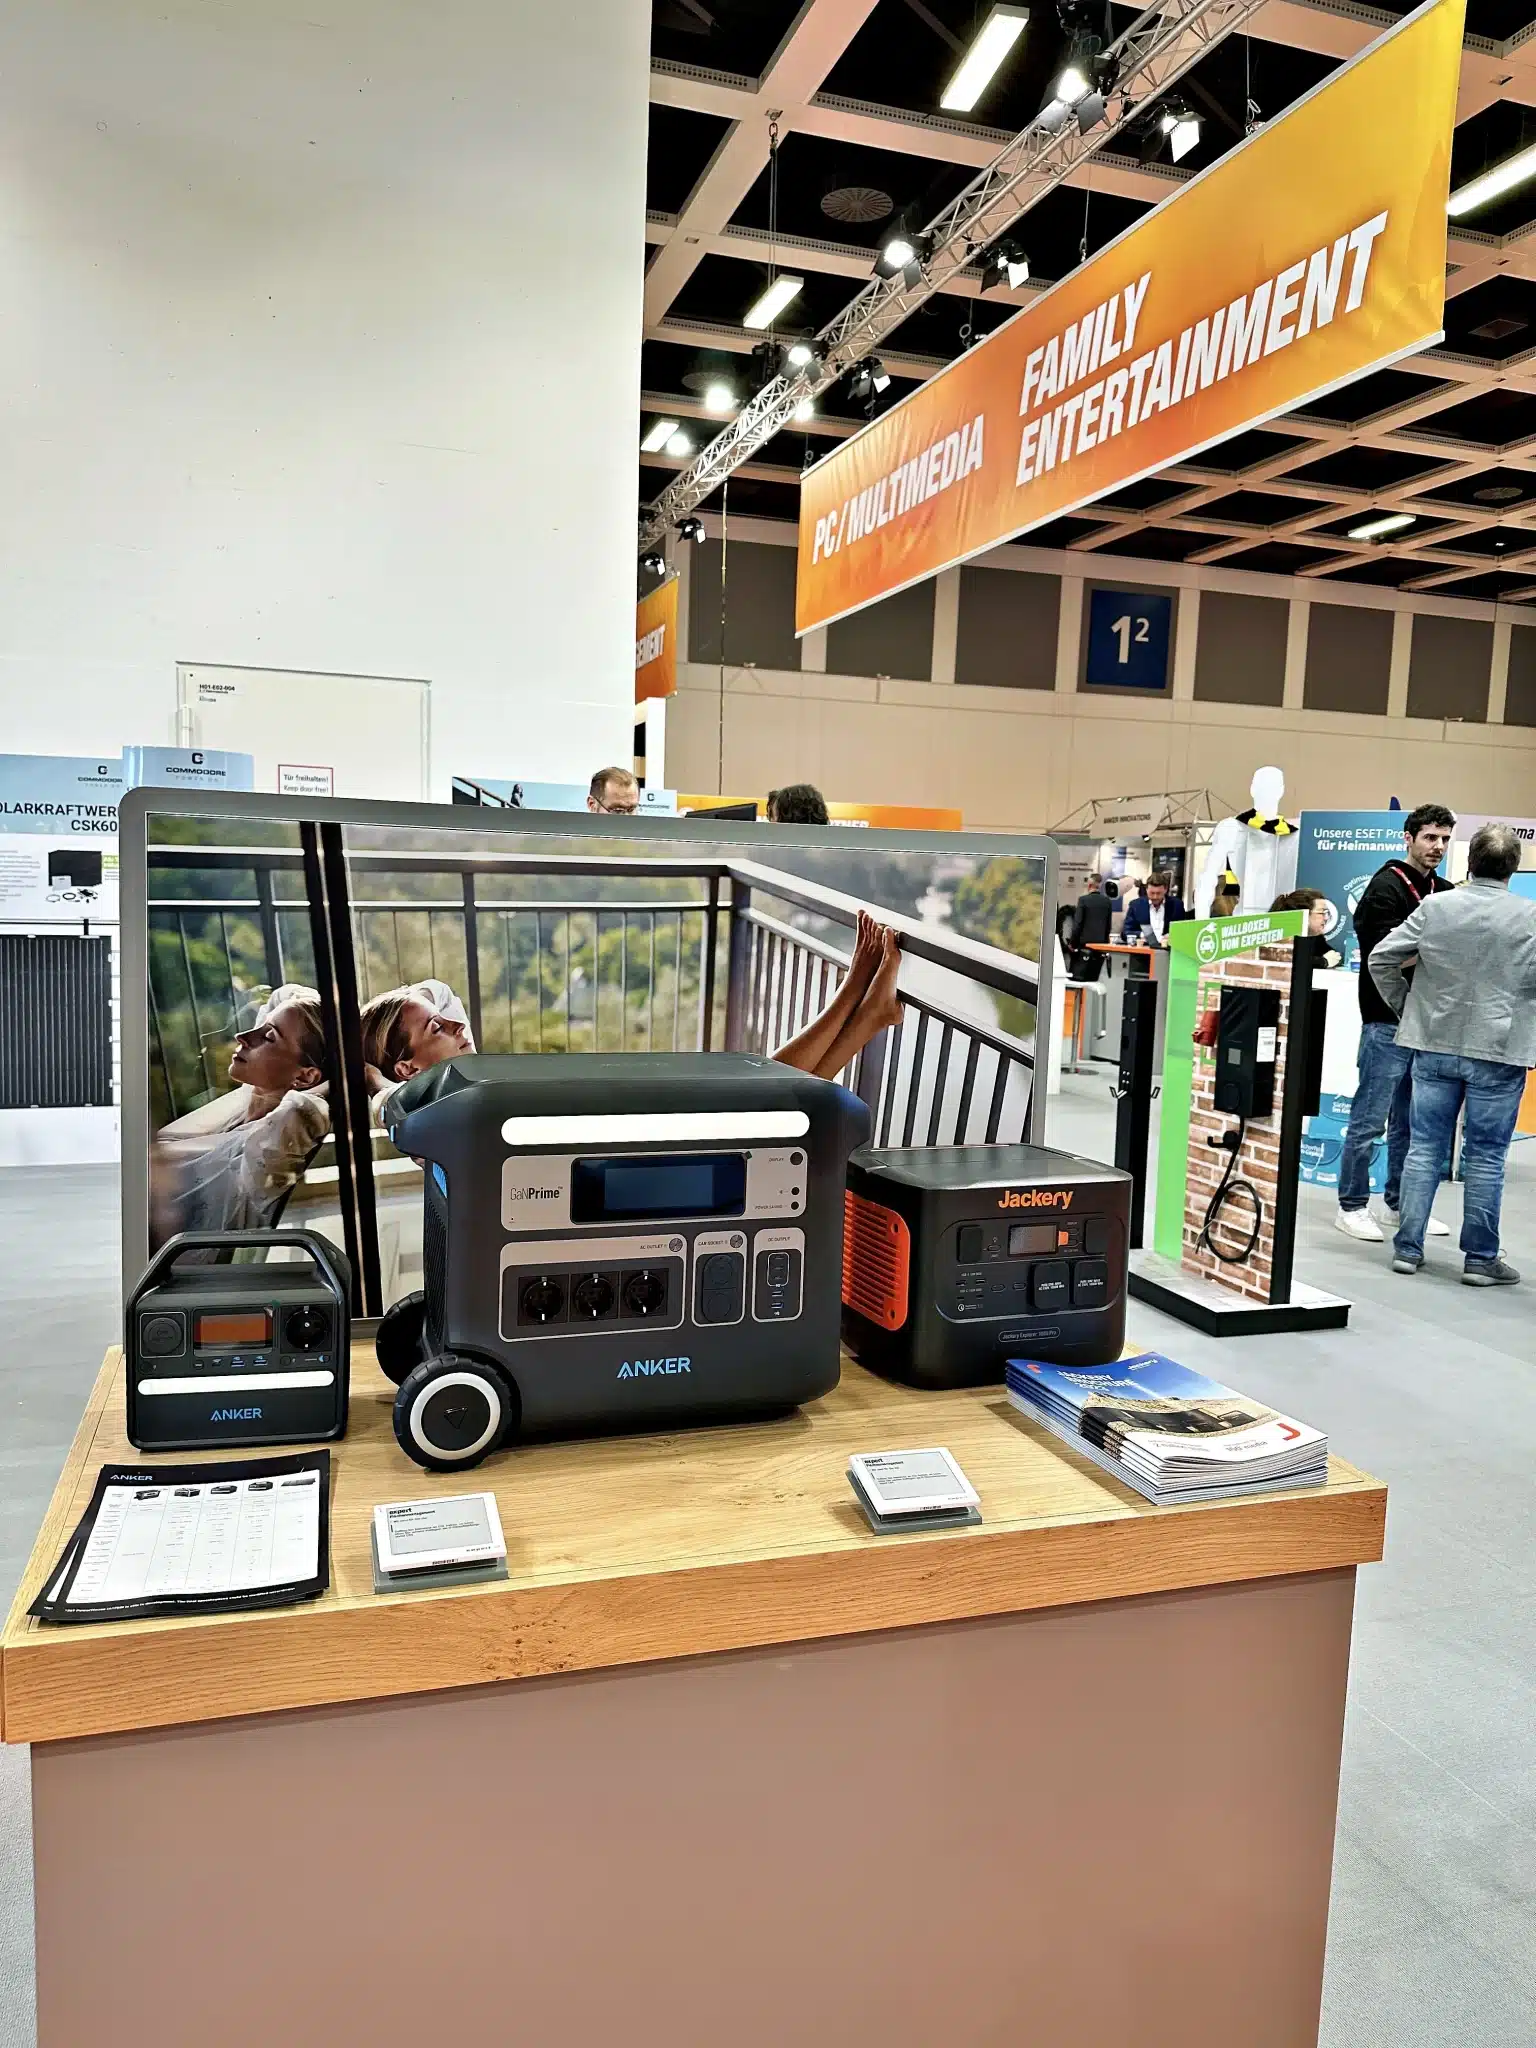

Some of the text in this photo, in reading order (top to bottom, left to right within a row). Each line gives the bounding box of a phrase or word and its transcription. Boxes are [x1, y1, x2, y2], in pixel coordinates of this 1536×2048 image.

[1016, 210, 1389, 488] ENTERTAINMENT
[1018, 271, 1152, 417] FAMILY
[165, 767, 227, 777] COMMODORE
[0, 802, 119, 818] LARKRAFTWER
[1313, 828, 1405, 839] Unsere ESET Pro
[1317, 840, 1336, 851] für
[1221, 918, 1270, 937] WALLBOXEN
[1221, 928, 1284, 951] VOM EXPERTEN
[998, 1189, 1074, 1210] Jackery
[616, 1356, 691, 1379] ANKER
[210, 1407, 263, 1421] ANKER
